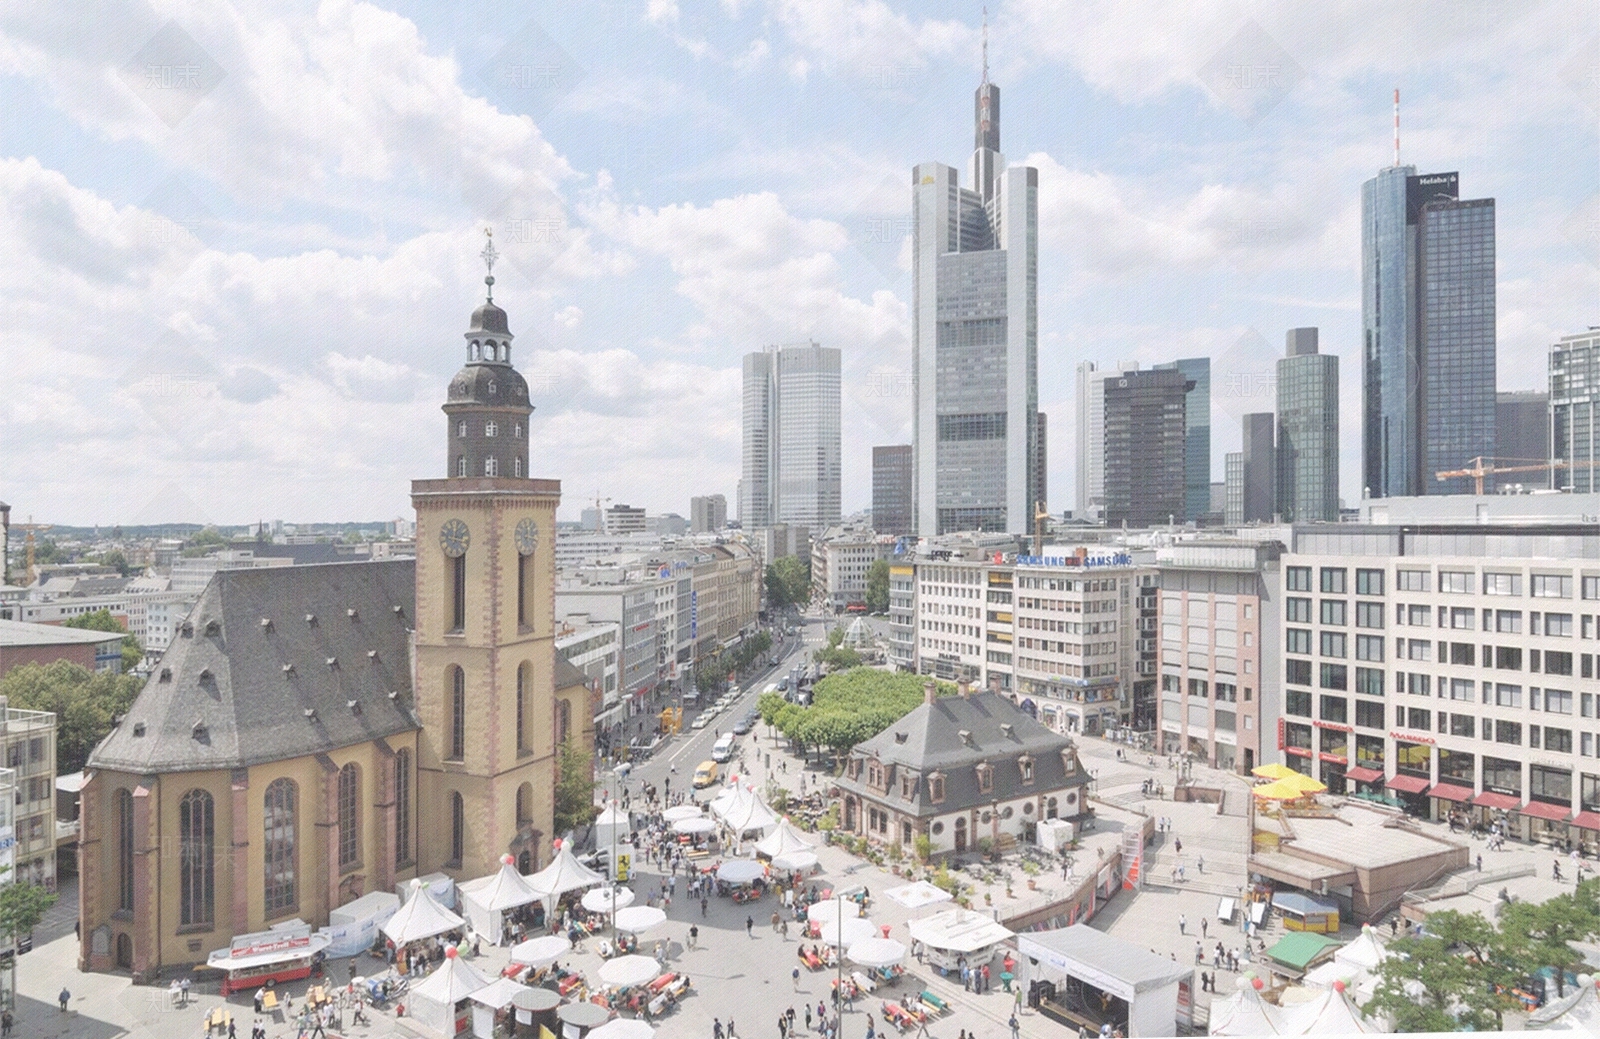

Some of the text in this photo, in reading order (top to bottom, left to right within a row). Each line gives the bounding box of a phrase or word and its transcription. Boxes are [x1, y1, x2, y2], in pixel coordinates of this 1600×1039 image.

[1419, 176, 1447, 185] Helaba
[1016, 554, 1066, 567] SAMSUNG
[1084, 554, 1133, 567] SAMSUNG
